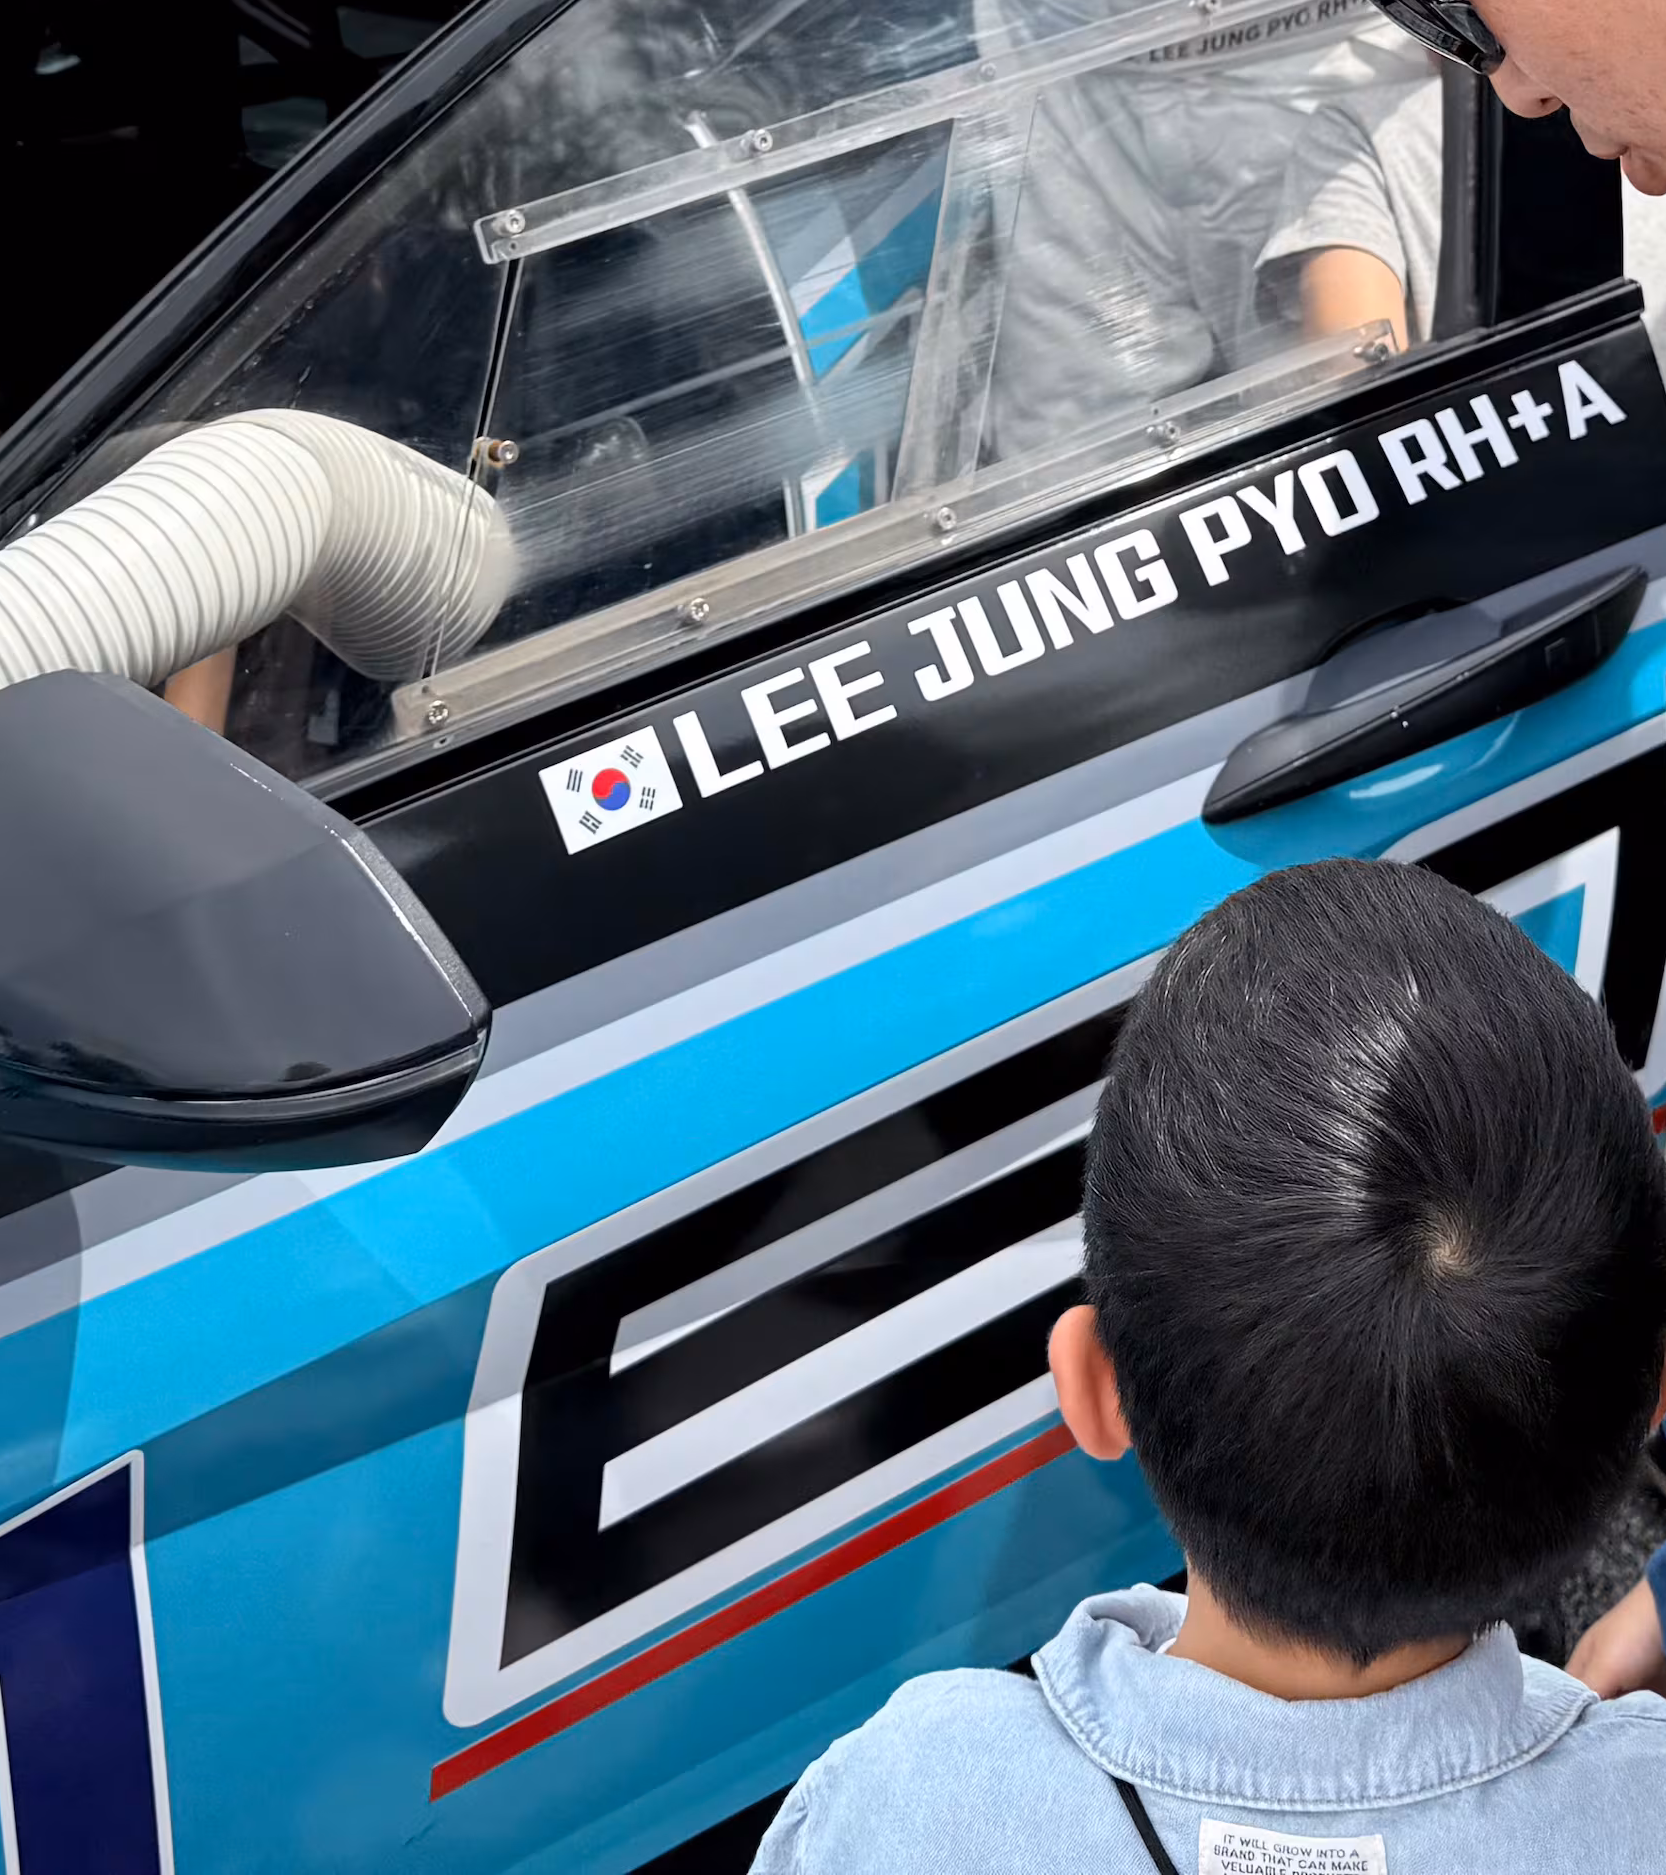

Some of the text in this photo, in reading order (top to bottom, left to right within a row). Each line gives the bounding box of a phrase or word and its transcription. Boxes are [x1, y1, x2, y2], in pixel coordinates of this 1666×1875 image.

[1148, 41, 1190, 63] LEE
[1197, 24, 1261, 57] JUNG
[673, 359, 1628, 799] LEE JUNG PYO RH+A
[1213, 1844, 1255, 1861] BRAND
[1261, 1852, 1294, 1868] THAT
[1298, 1859, 1327, 1871] CAN
[1331, 1860, 1368, 1872] MAKE
[1222, 1833, 1360, 1859] IT WILL GROW INTO A
